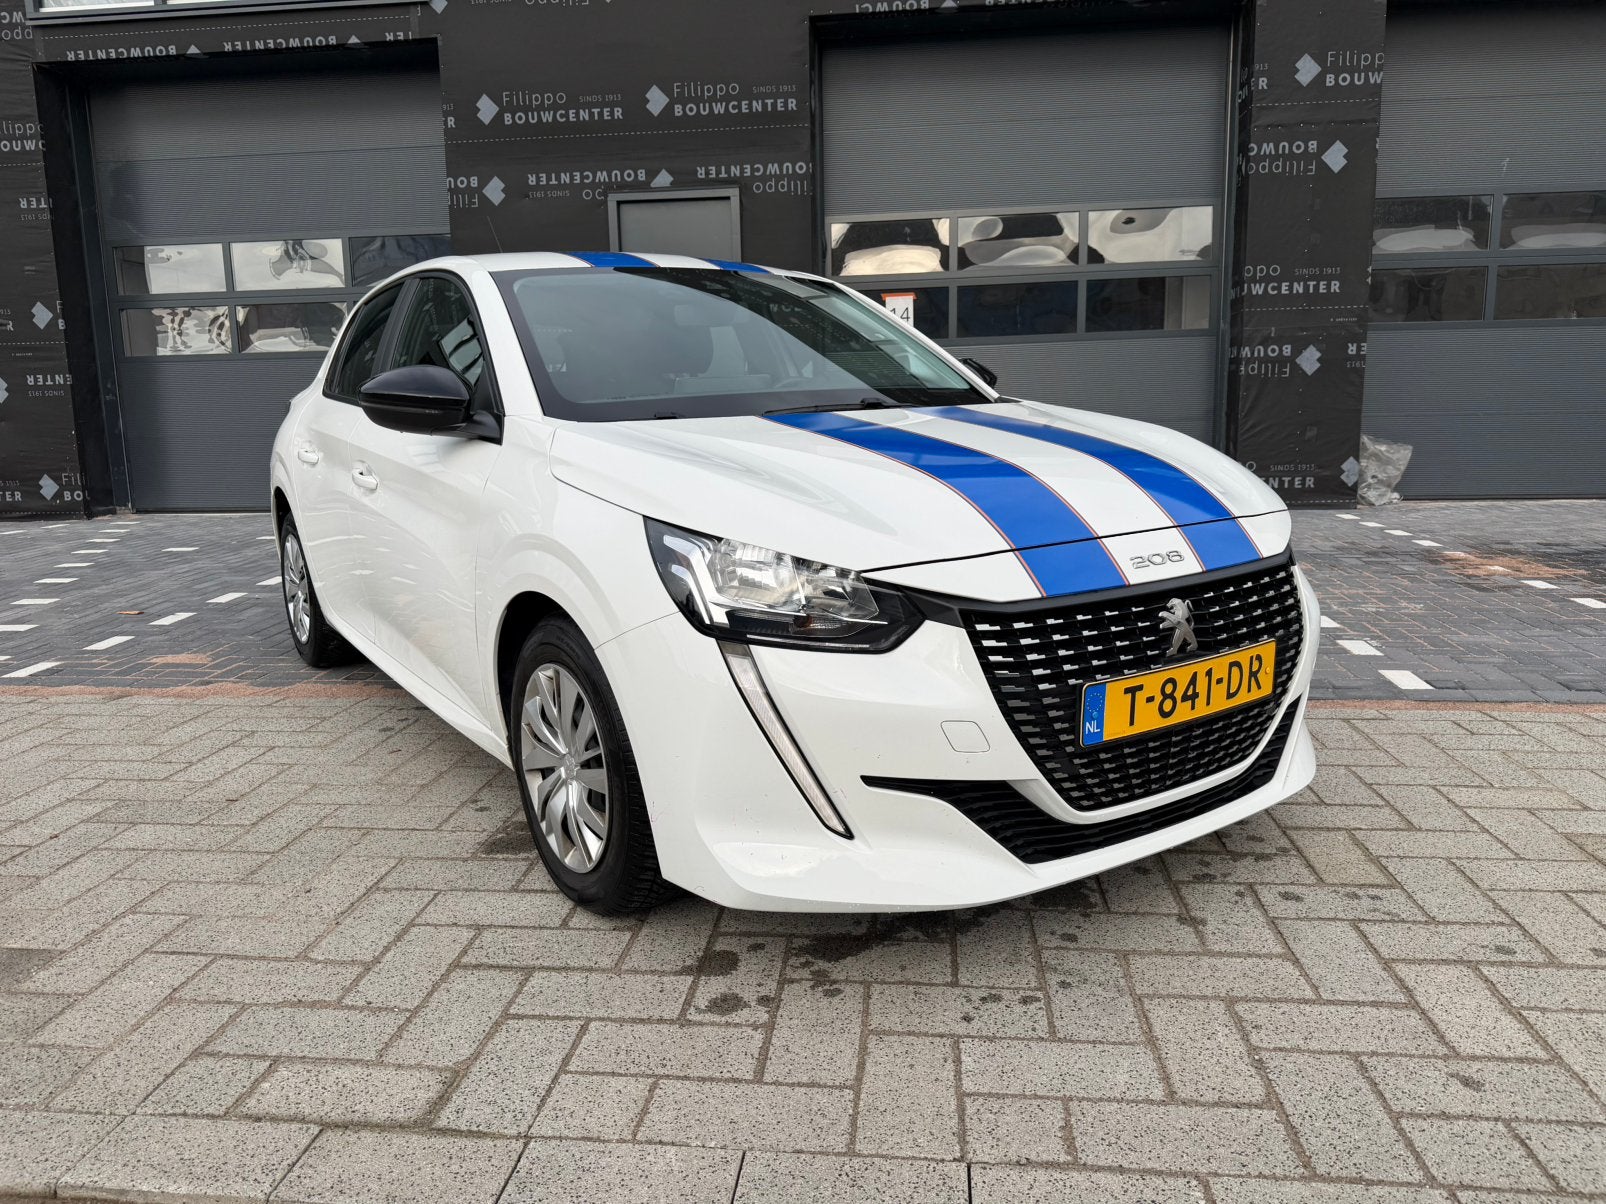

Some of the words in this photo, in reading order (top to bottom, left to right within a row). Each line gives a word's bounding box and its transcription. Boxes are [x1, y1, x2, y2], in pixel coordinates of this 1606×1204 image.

[502, 90, 567, 108] Filippo
[579, 95, 602, 103] SINDS
[605, 93, 622, 102] 1913
[673, 81, 740, 100] Filippo
[752, 86, 777, 94] SINDS
[779, 84, 797, 93] 1913
[503, 107, 624, 125] BOUWCENTER
[674, 98, 798, 117] BOUWCENTER
[527, 168, 647, 186] BOUWCENTER
[697, 161, 813, 179] OUWCENTER
[547, 189, 570, 198] SINDS
[752, 177, 813, 196] ilippo
[1294, 267, 1321, 276] SINDS
[1322, 266, 1341, 275] 1913
[1269, 464, 1295, 472] SINDS
[1260, 476, 1316, 489] NTER
[1129, 550, 1185, 570] 208
[1123, 652, 1264, 728] T-841-DR
[1085, 720, 1101, 735] NL
